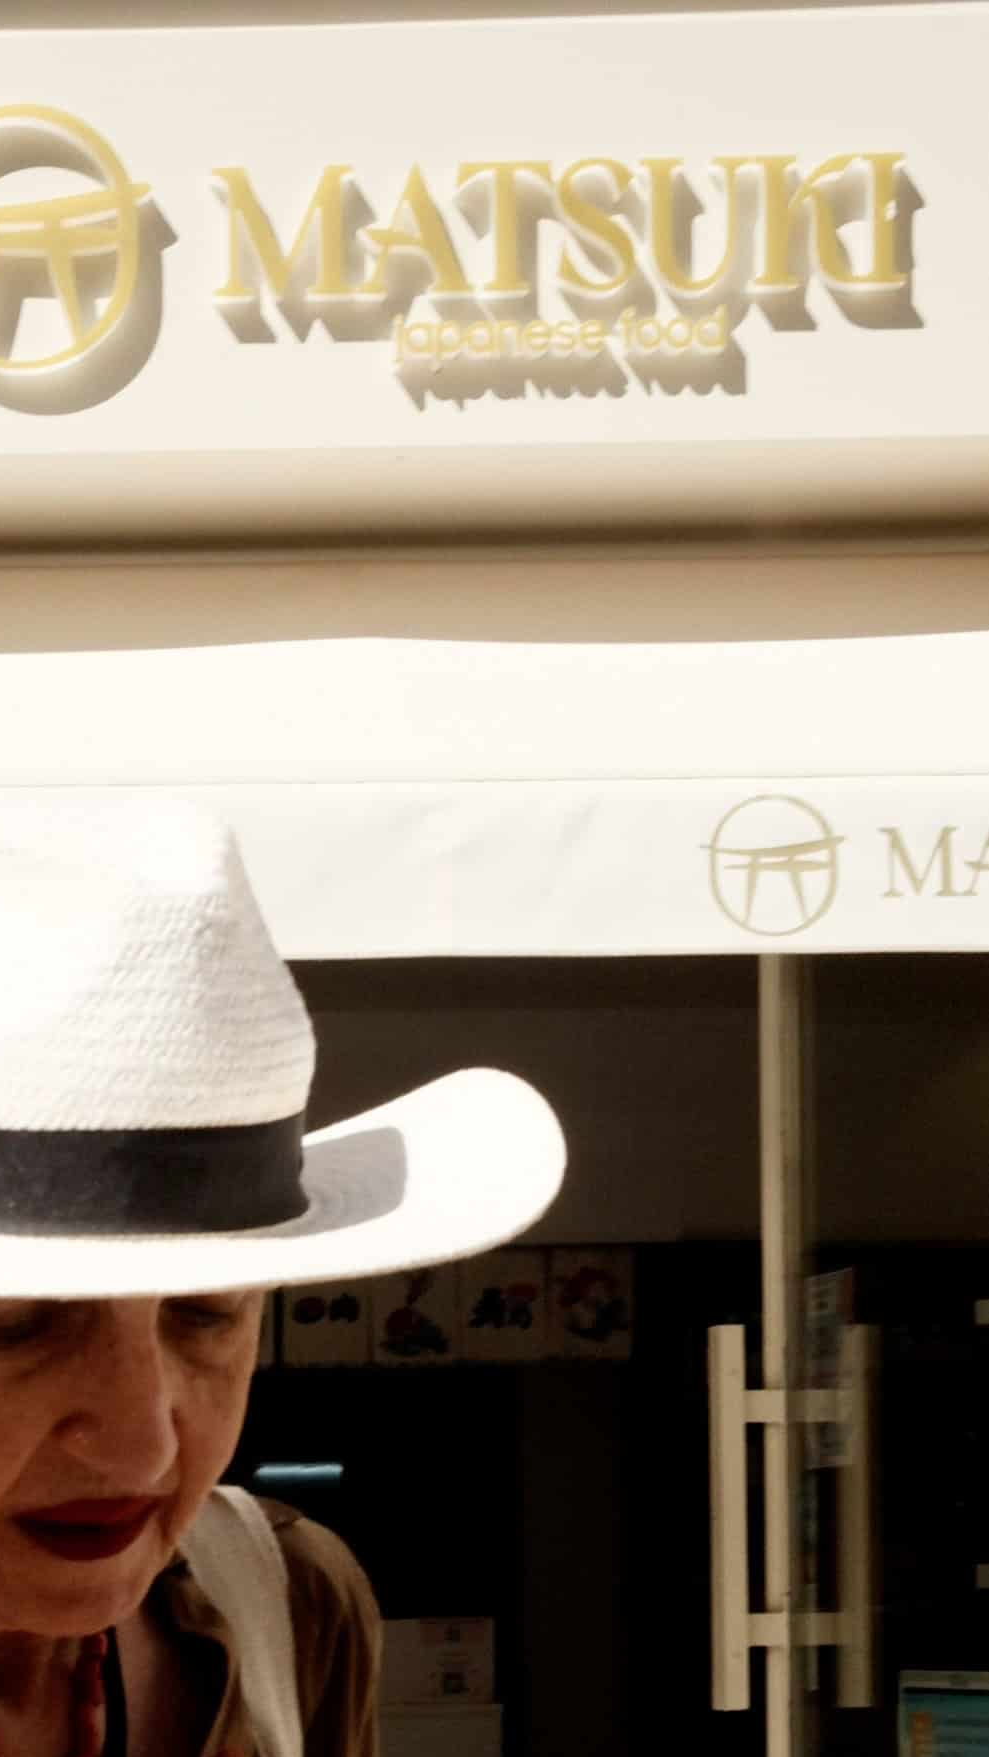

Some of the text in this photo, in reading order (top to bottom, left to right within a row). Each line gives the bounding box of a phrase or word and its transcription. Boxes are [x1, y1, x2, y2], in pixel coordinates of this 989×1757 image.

[213, 153, 909, 297] MATSUKI
[393, 304, 728, 373] japanese food
